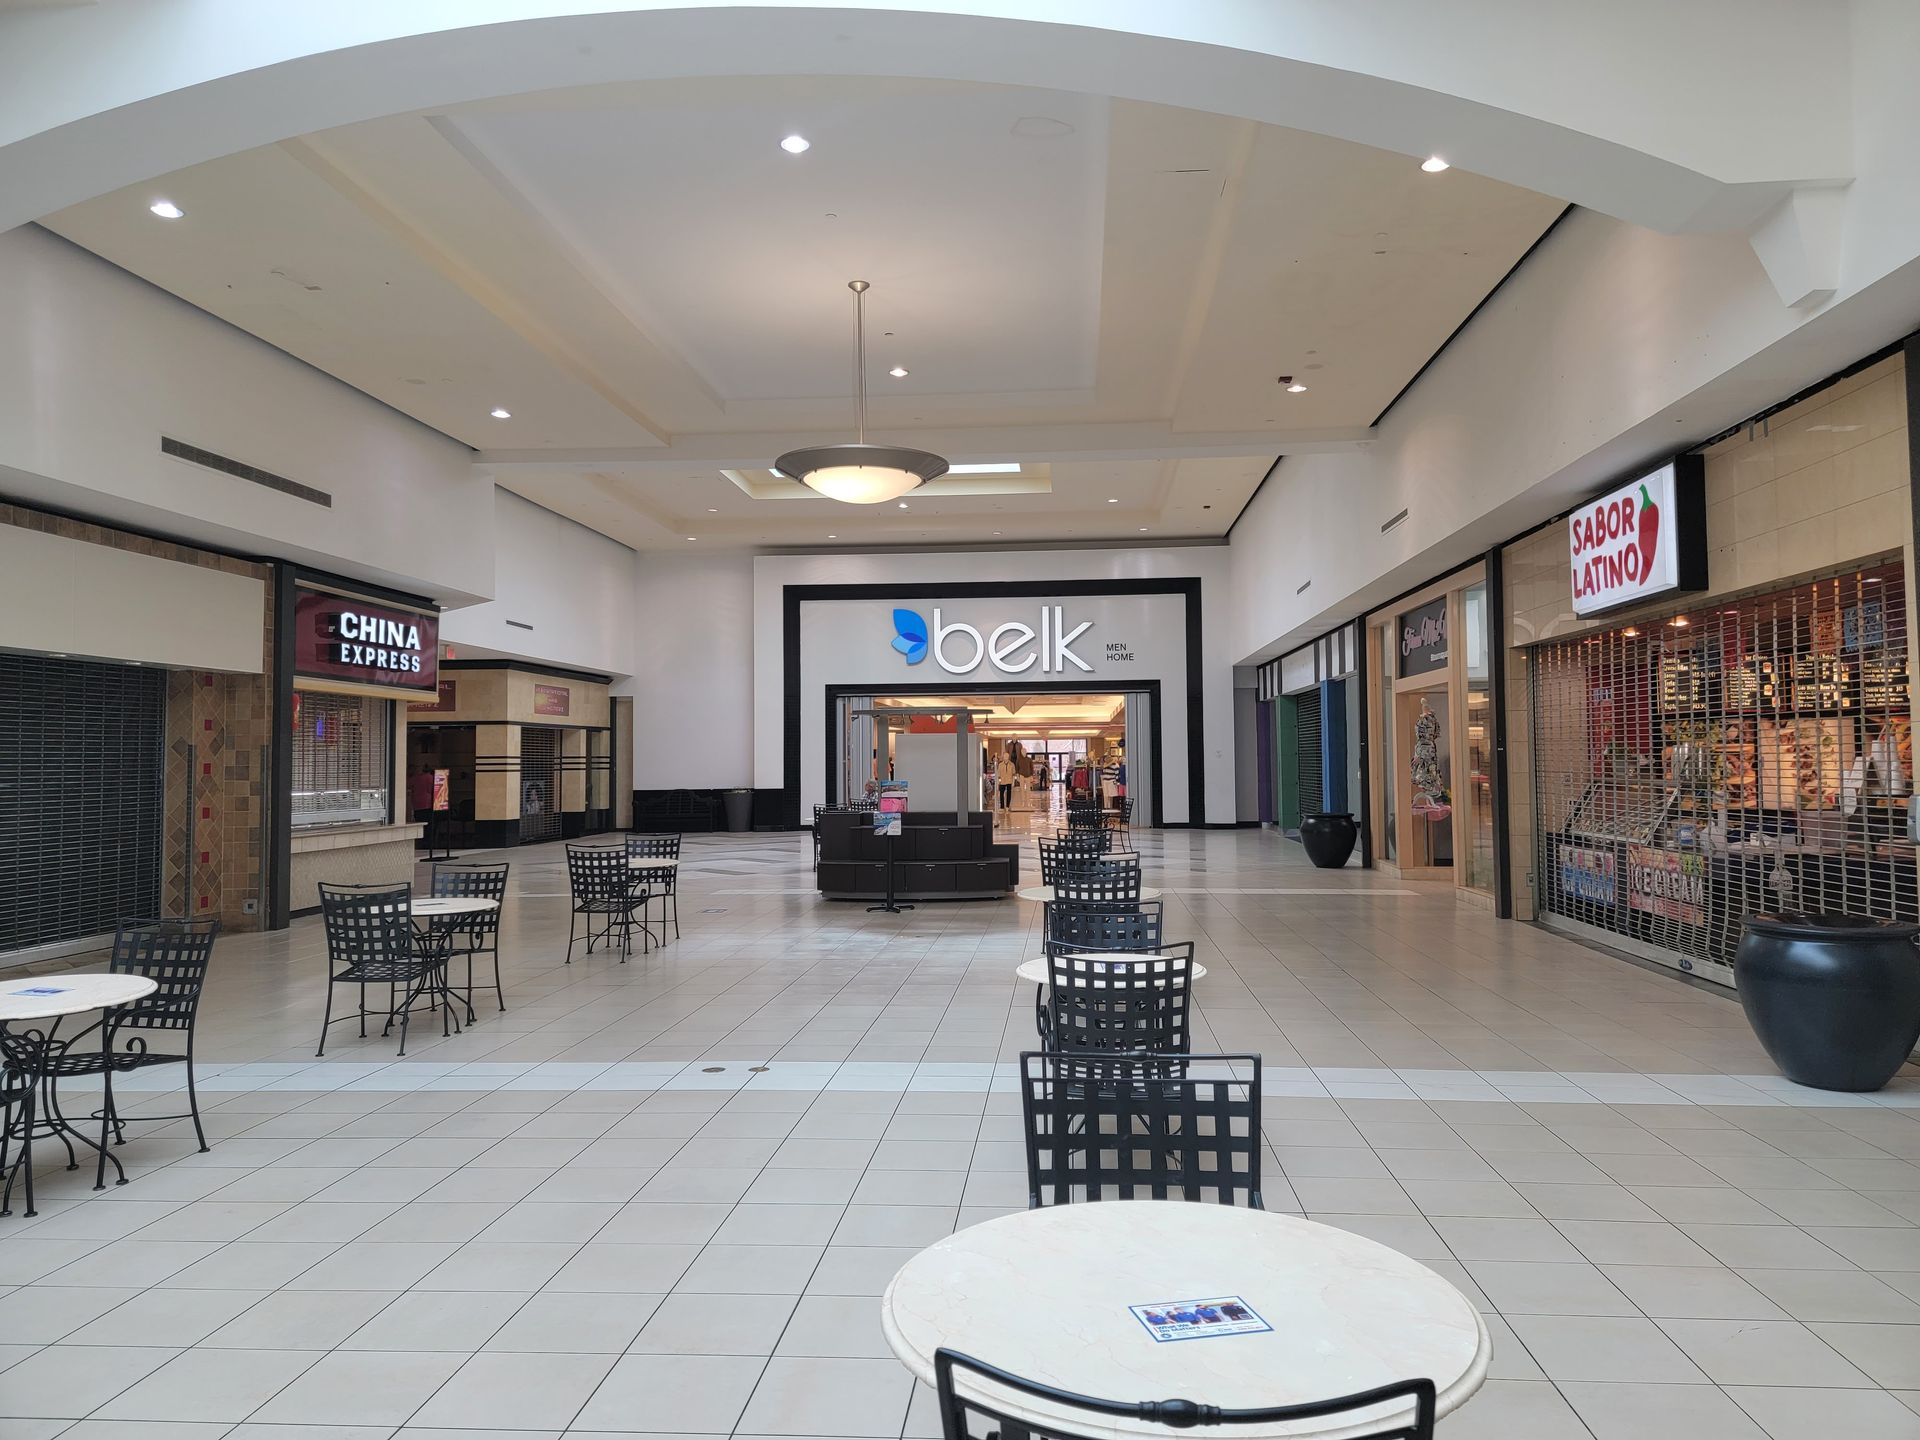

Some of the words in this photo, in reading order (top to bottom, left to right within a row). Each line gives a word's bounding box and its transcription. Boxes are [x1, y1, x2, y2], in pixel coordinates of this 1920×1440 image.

[1572, 496, 1636, 555] SABOR
[1573, 542, 1639, 599] LATINO
[340, 611, 421, 651] CHINA
[933, 606, 1096, 674] belk
[1106, 643, 1127, 652] MEN
[341, 643, 421, 673] EXPRESS
[1106, 653, 1135, 661] HOME
